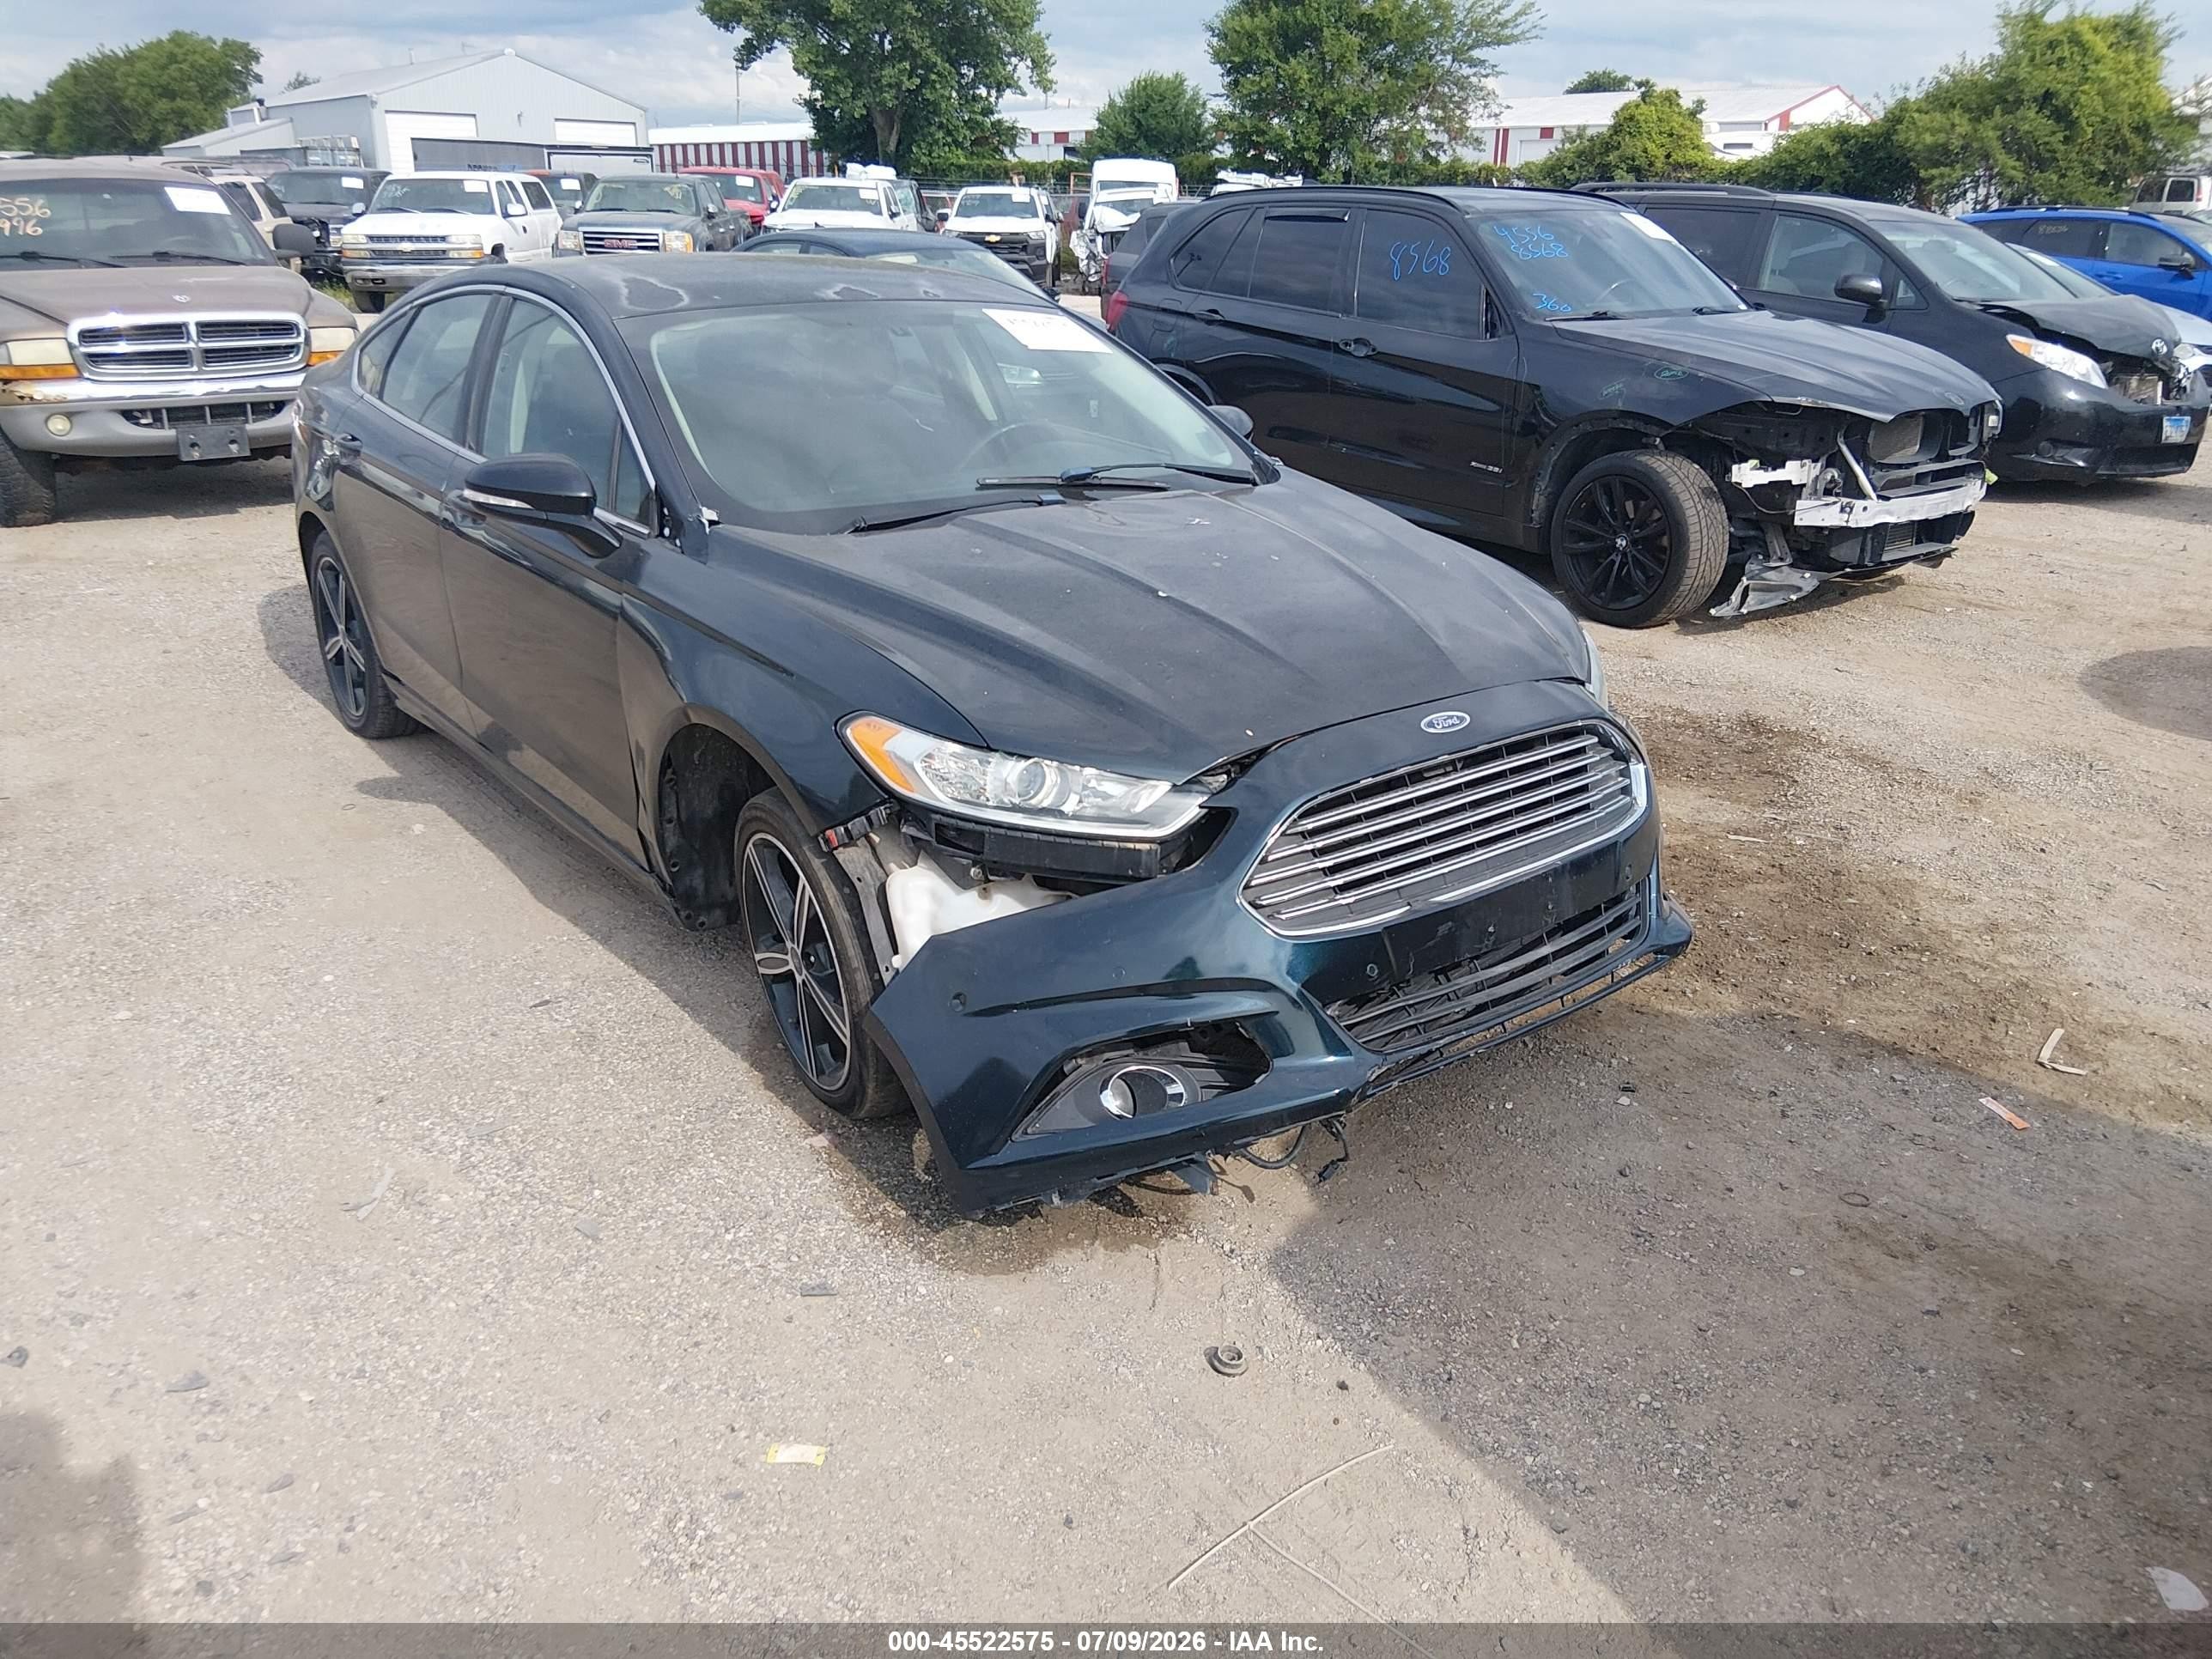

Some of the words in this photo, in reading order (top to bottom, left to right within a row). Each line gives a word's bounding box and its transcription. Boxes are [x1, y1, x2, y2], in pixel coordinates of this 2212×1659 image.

[604, 239, 637, 249] GMC
[1389, 240, 1451, 282] 8568
[1432, 715, 1461, 730] Ford
